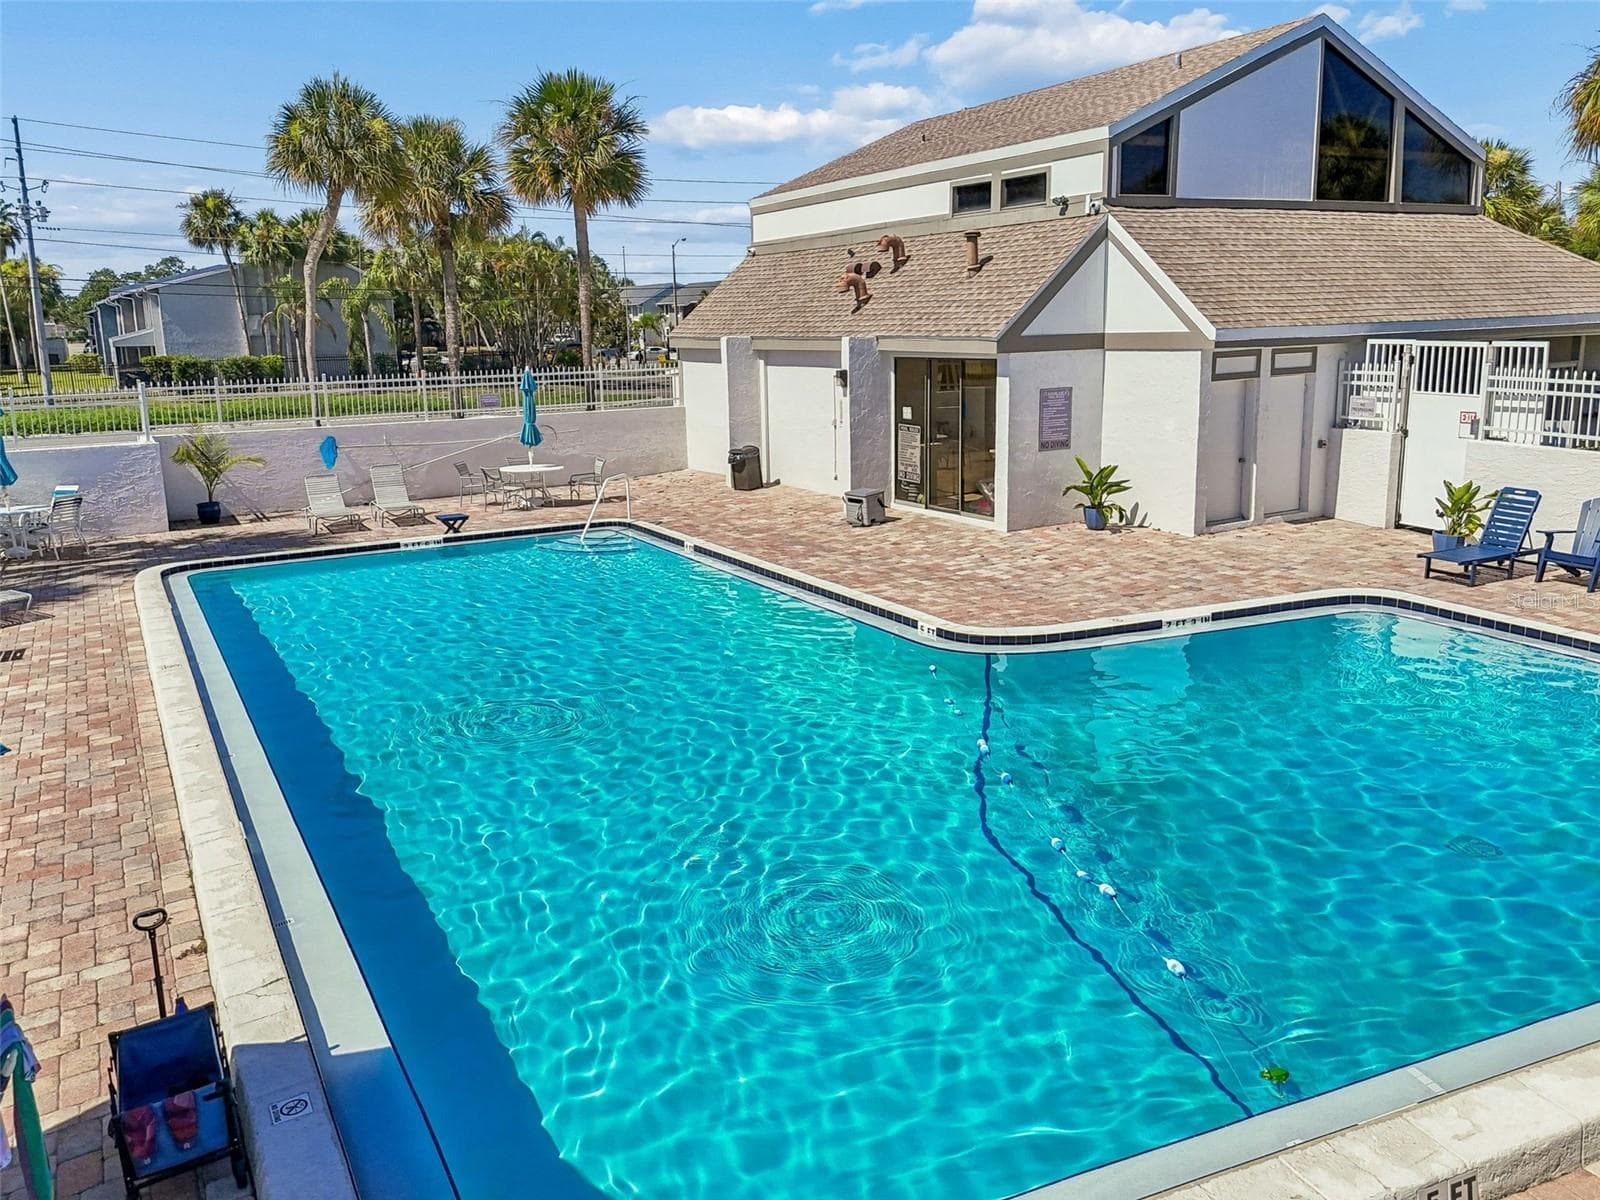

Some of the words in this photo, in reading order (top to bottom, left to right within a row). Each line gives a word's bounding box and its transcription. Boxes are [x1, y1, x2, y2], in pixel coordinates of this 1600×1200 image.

[1040, 440, 1049, 449] NO
[1050, 439, 1069, 449] DIVING
[1450, 1175, 1476, 1200] FT
